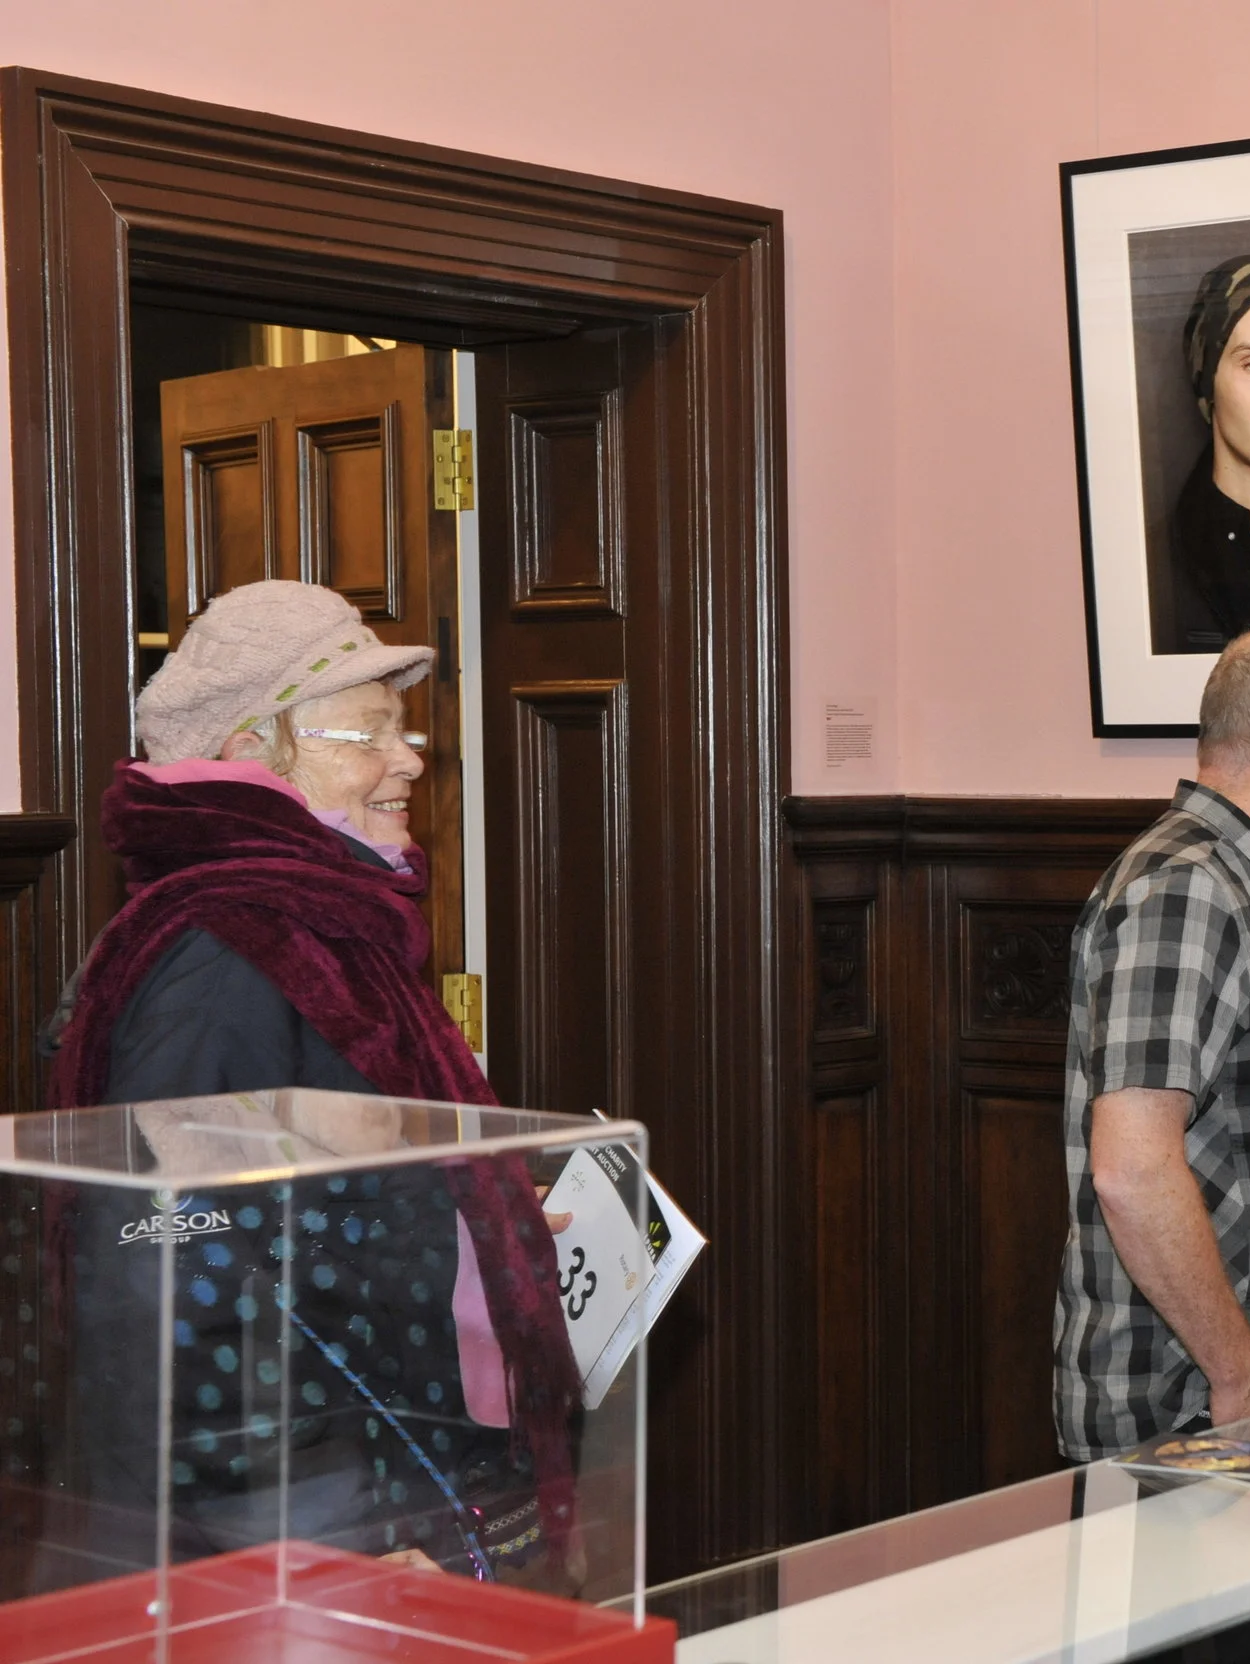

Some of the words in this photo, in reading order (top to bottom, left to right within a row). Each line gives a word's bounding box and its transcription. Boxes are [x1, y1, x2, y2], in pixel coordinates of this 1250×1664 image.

[597, 1153, 620, 1182] AUCTION
[604, 1145, 628, 1173] CHARITY
[557, 1246, 597, 1321] 33
